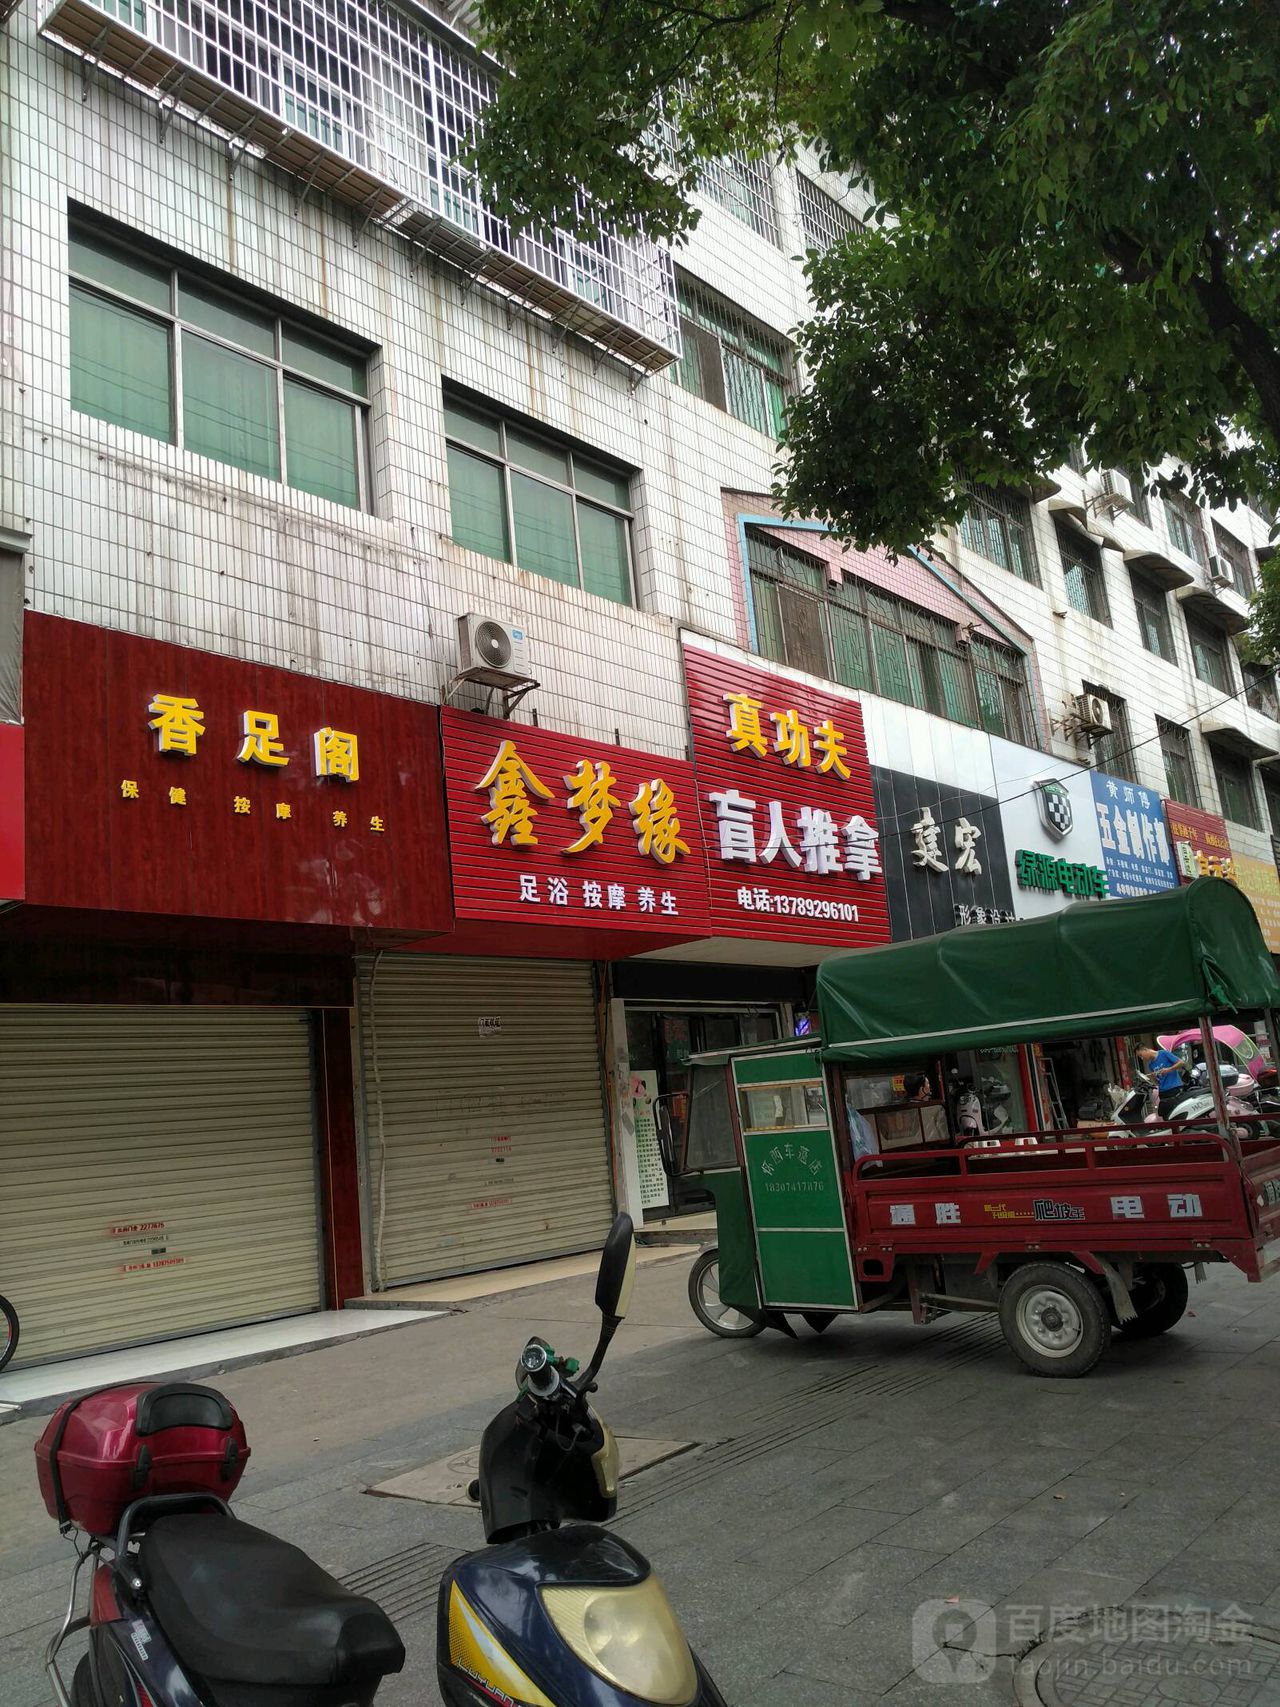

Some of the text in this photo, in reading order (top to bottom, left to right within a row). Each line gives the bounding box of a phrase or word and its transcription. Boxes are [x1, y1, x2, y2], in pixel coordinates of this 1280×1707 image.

[149, 693, 359, 783] 香足阁
[722, 692, 851, 780] 真功夫
[475, 740, 691, 864] 鑫梦缘
[709, 789, 883, 881] 盲人推拿
[1096, 802, 1171, 866] 五金制作部
[519, 874, 679, 916] 足浴 按摩 养生
[1016, 849, 1110, 900] 绿源电动车
[737, 886, 859, 922] 电话:13789296101
[1033, 1199, 1086, 1221] 爬坡王
[1110, 1193, 1203, 1219] 电动
